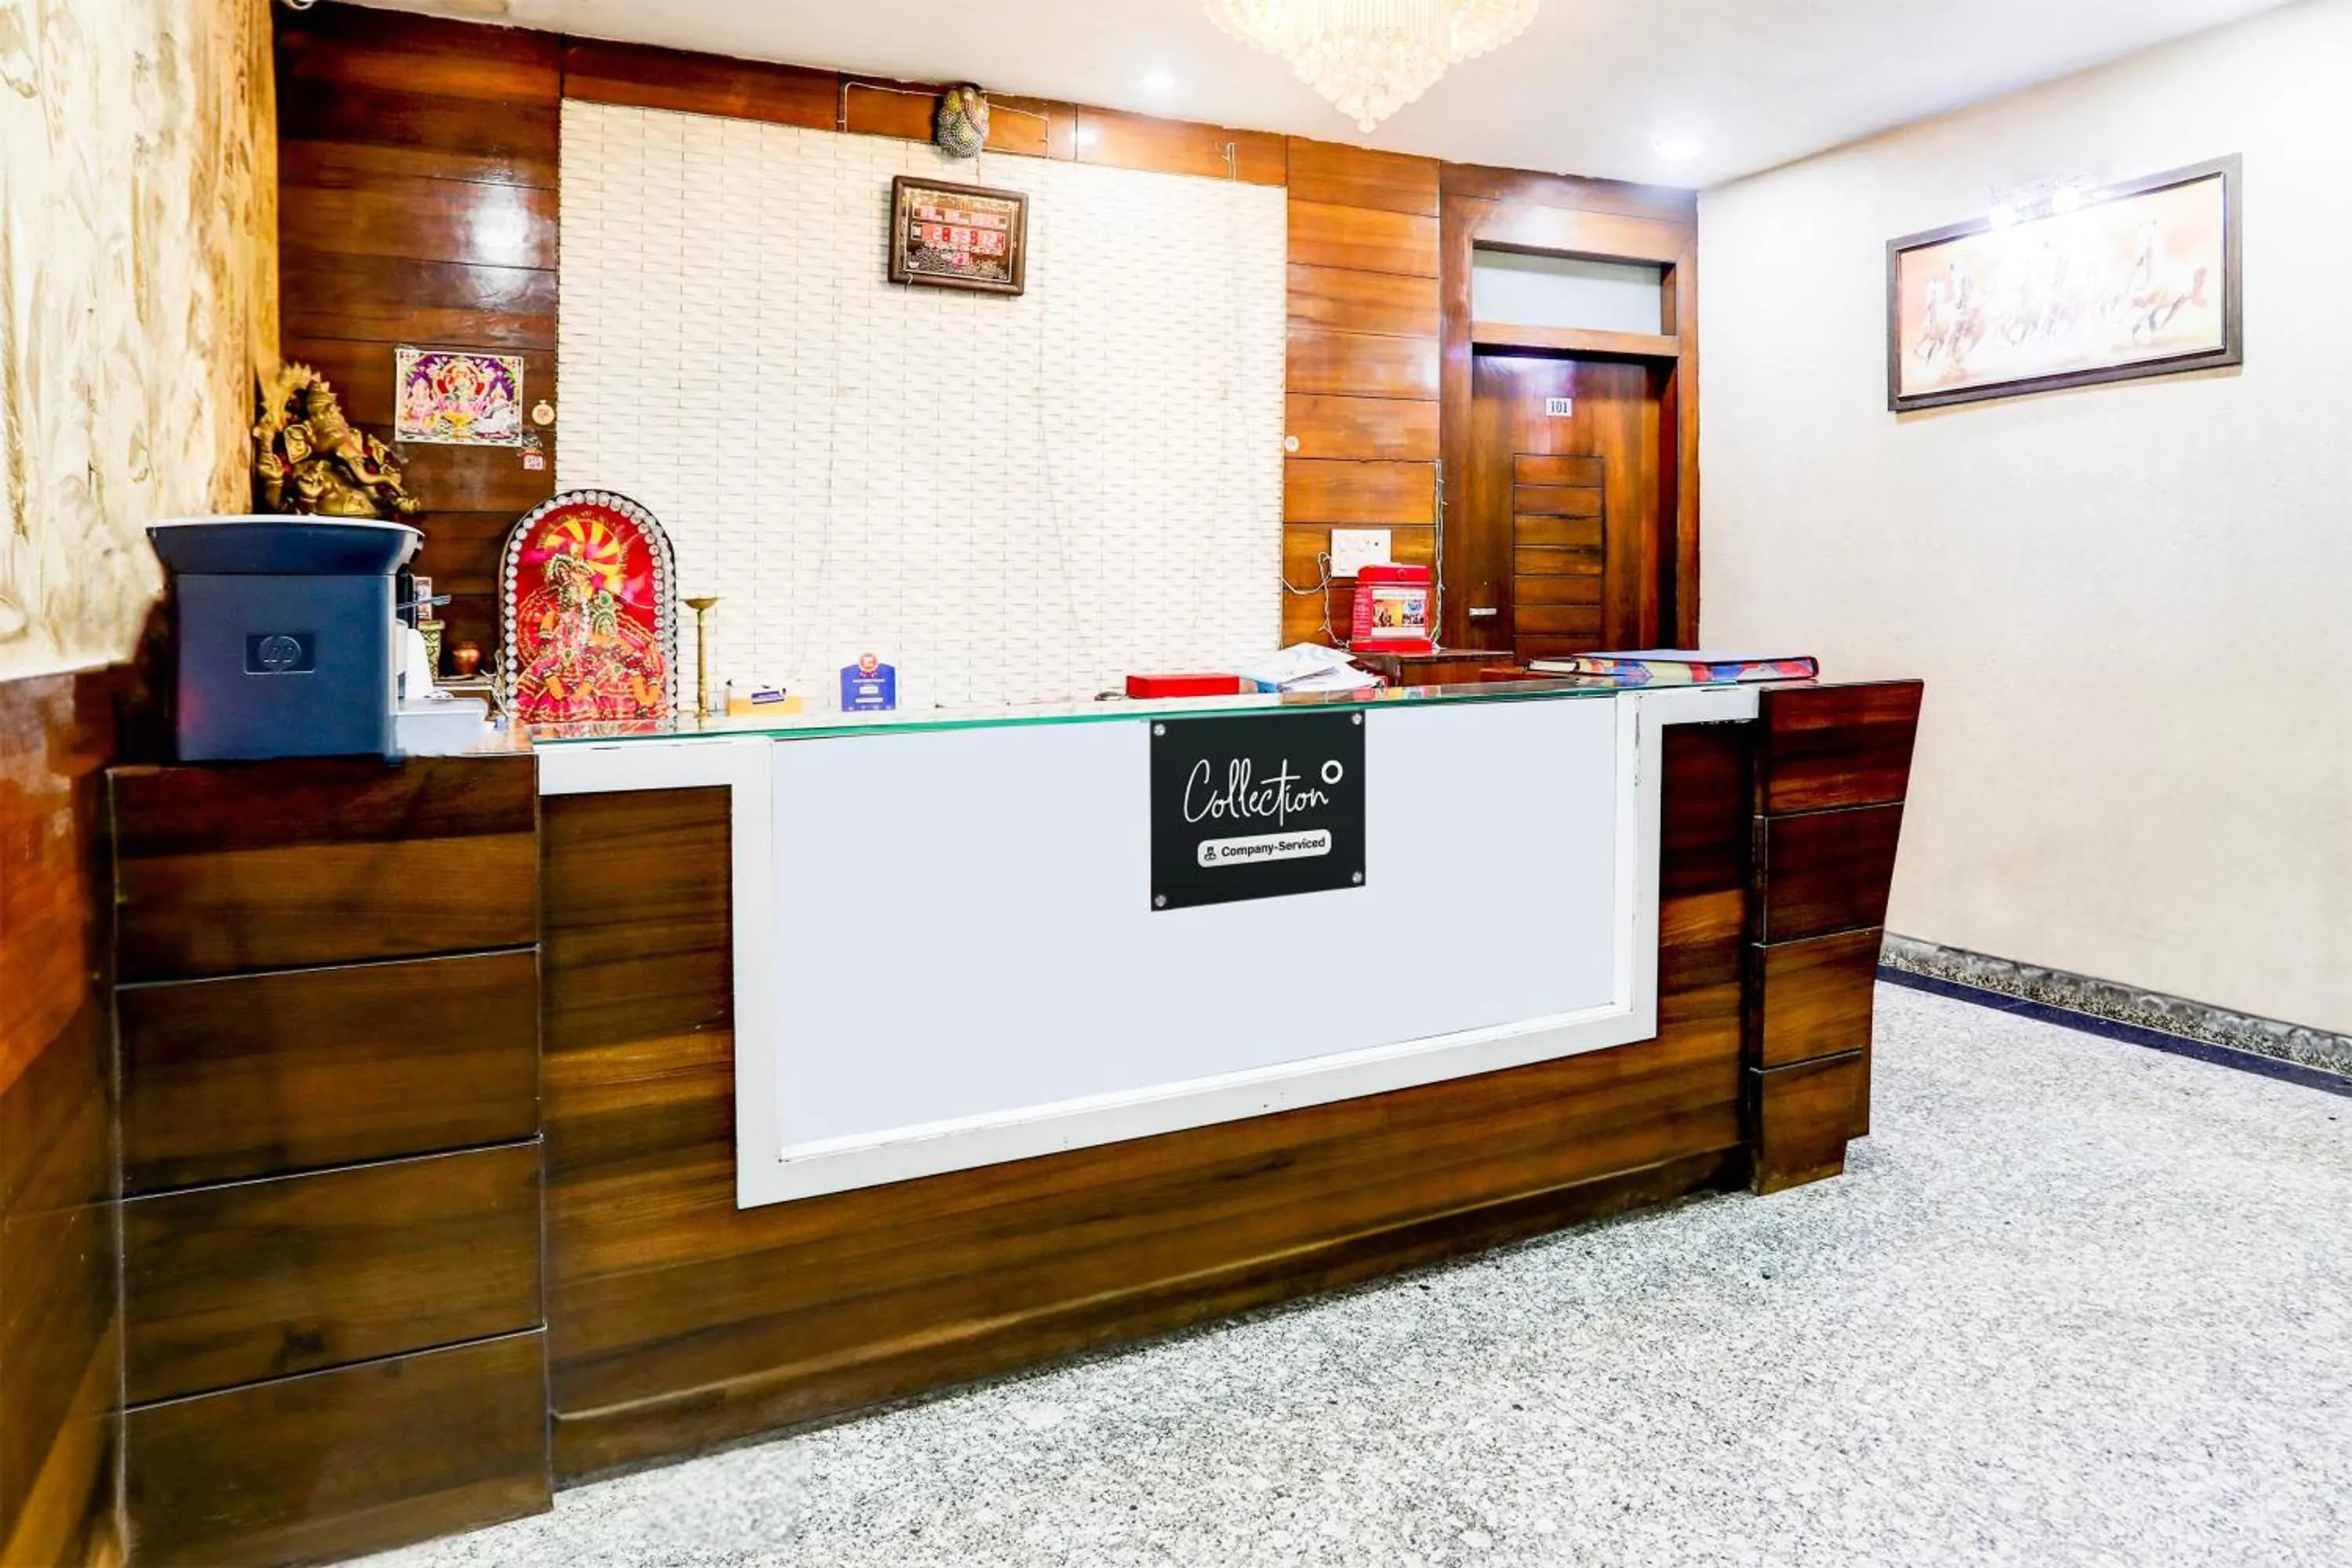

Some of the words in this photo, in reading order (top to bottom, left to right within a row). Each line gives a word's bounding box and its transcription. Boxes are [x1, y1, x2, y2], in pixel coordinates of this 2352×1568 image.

[1551, 401, 1567, 413] 101
[1184, 757, 1329, 826] Collection
[1221, 837, 1326, 858] Company-Serviced
